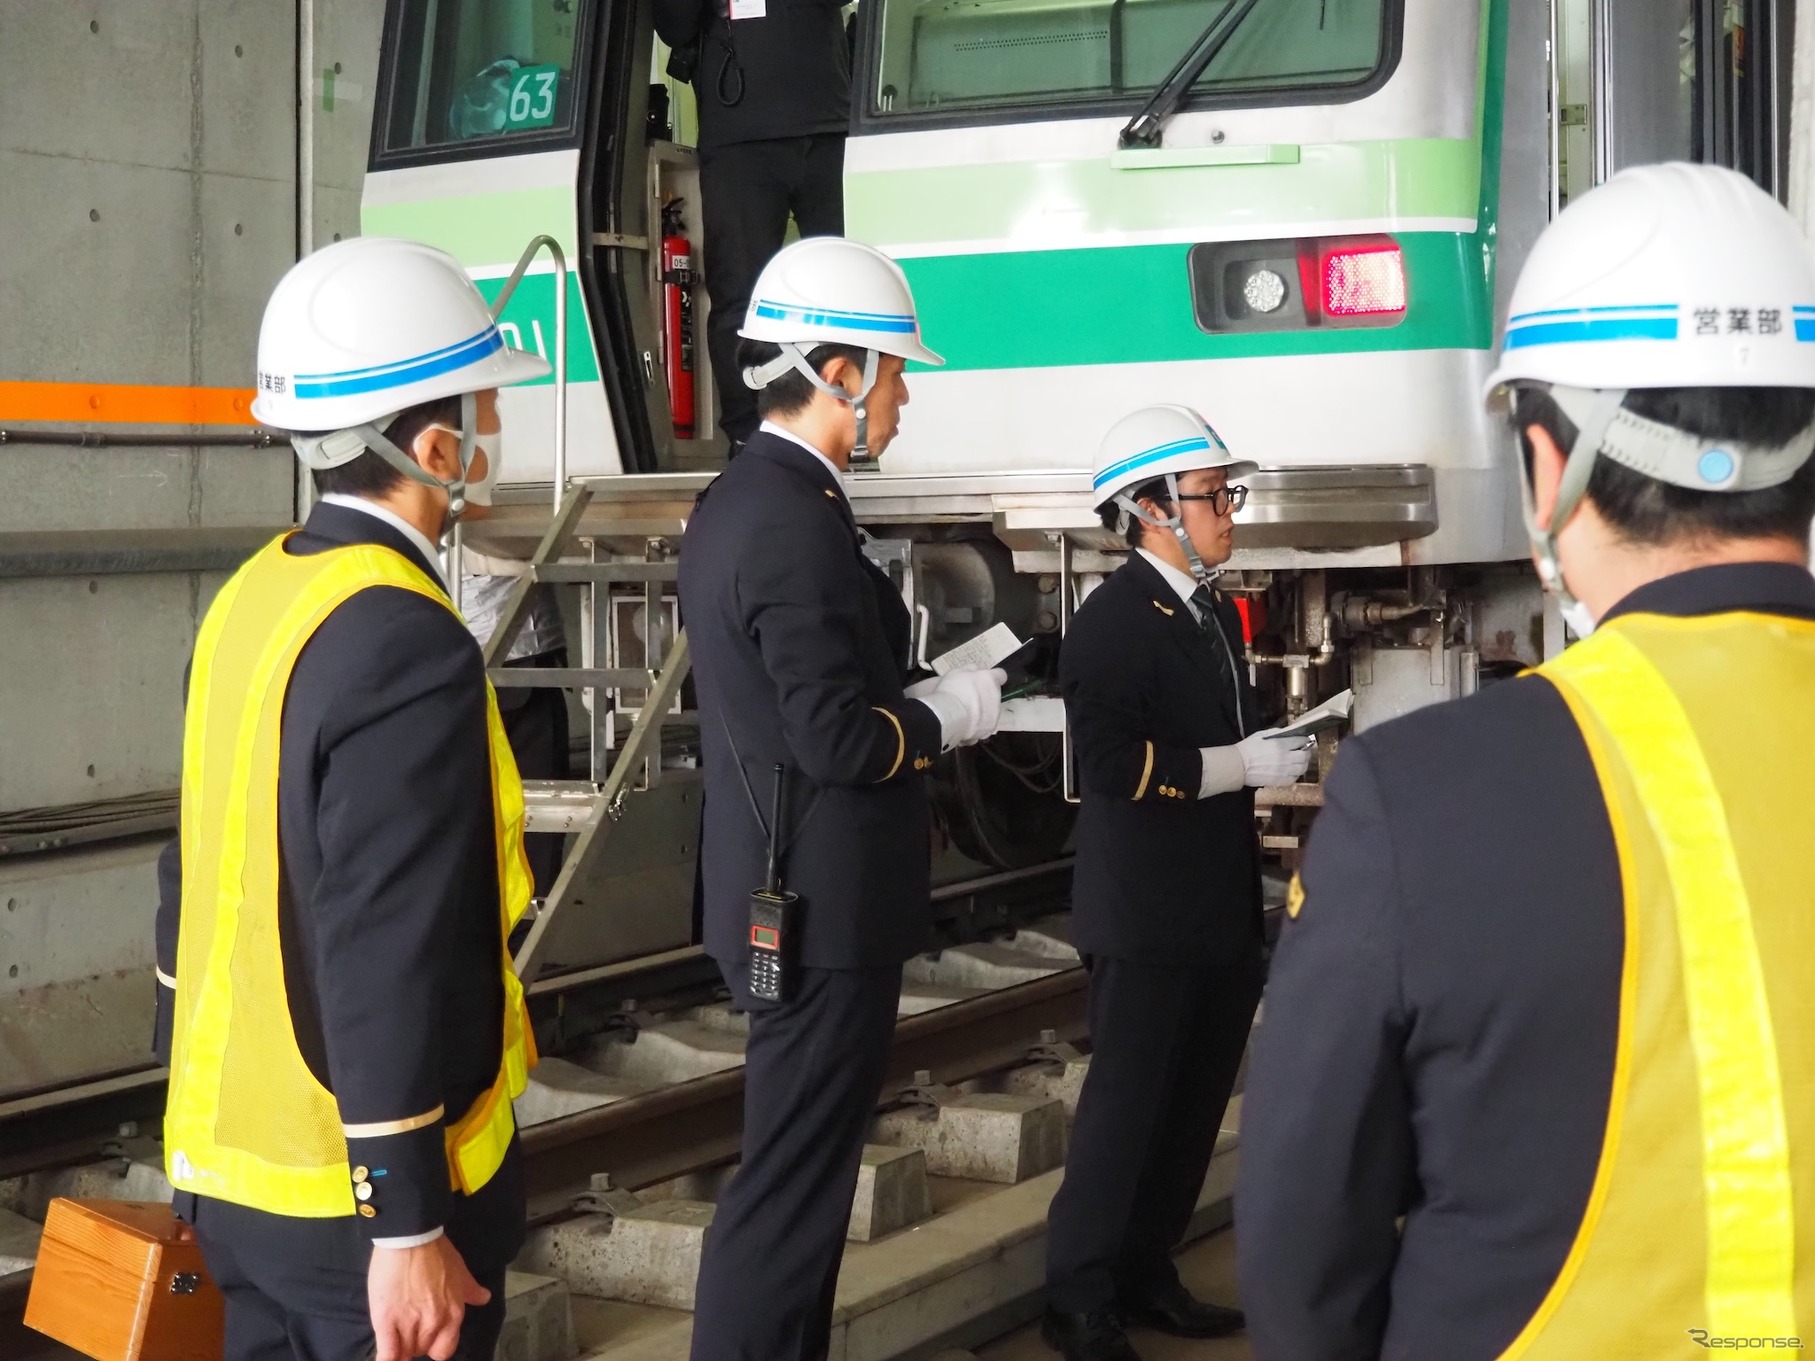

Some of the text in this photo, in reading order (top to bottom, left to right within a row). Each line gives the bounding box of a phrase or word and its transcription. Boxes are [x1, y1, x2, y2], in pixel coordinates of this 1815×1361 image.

[509, 71, 556, 122] 63
[674, 258, 690, 268] 05-
[1693, 307, 1782, 335] 営業部
